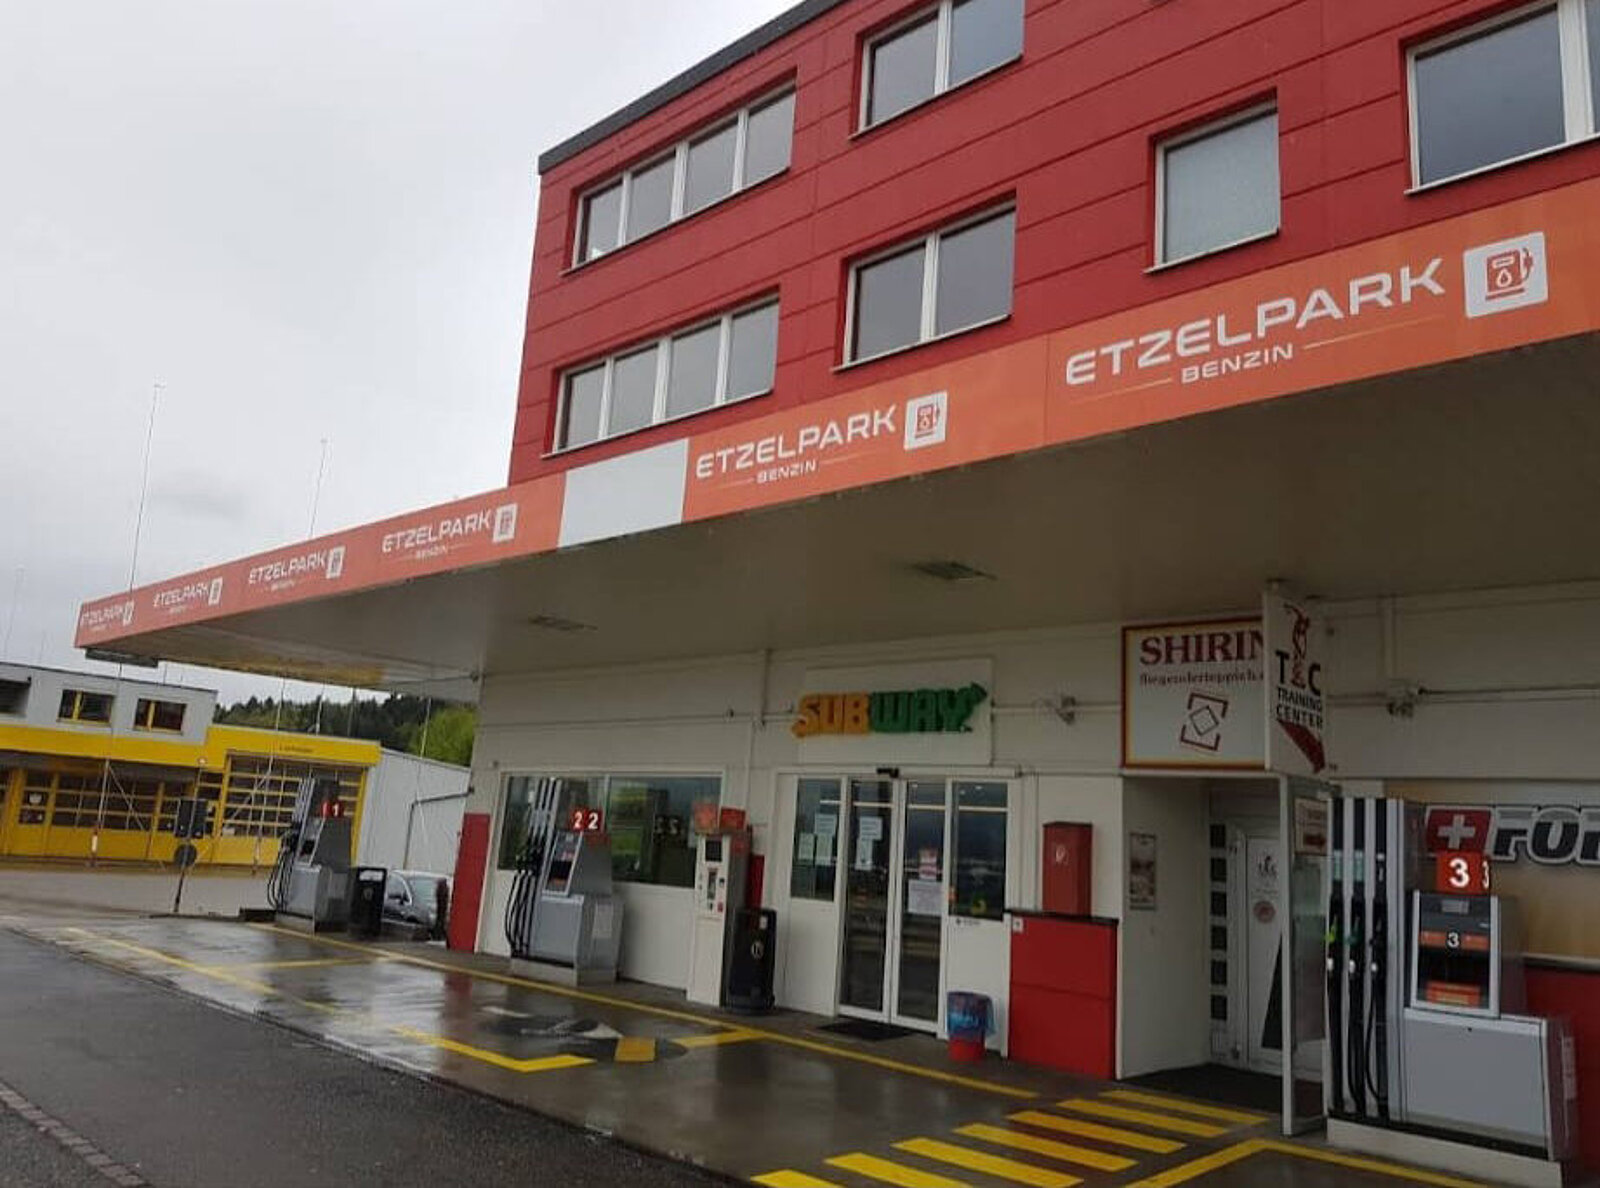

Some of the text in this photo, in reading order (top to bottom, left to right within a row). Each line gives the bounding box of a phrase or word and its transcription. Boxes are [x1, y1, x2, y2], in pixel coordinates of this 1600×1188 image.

[1066, 257, 1446, 386] ETZELPARK
[1181, 343, 1294, 385] BENZIN
[695, 403, 897, 480] ETZELPARK
[756, 459, 817, 484] BENZIN
[381, 508, 491, 553] ETZELPARK
[248, 549, 328, 585] ETZELPARK
[791, 682, 987, 738] SUBWAY
[1277, 686, 1323, 713] TRAINING
[1276, 703, 1323, 730] CENTER
[332, 803, 339, 817] 1
[574, 811, 584, 830] 2
[587, 812, 598, 830] 2
[1449, 858, 1470, 888] 3
[1446, 932, 1460, 949] 3
